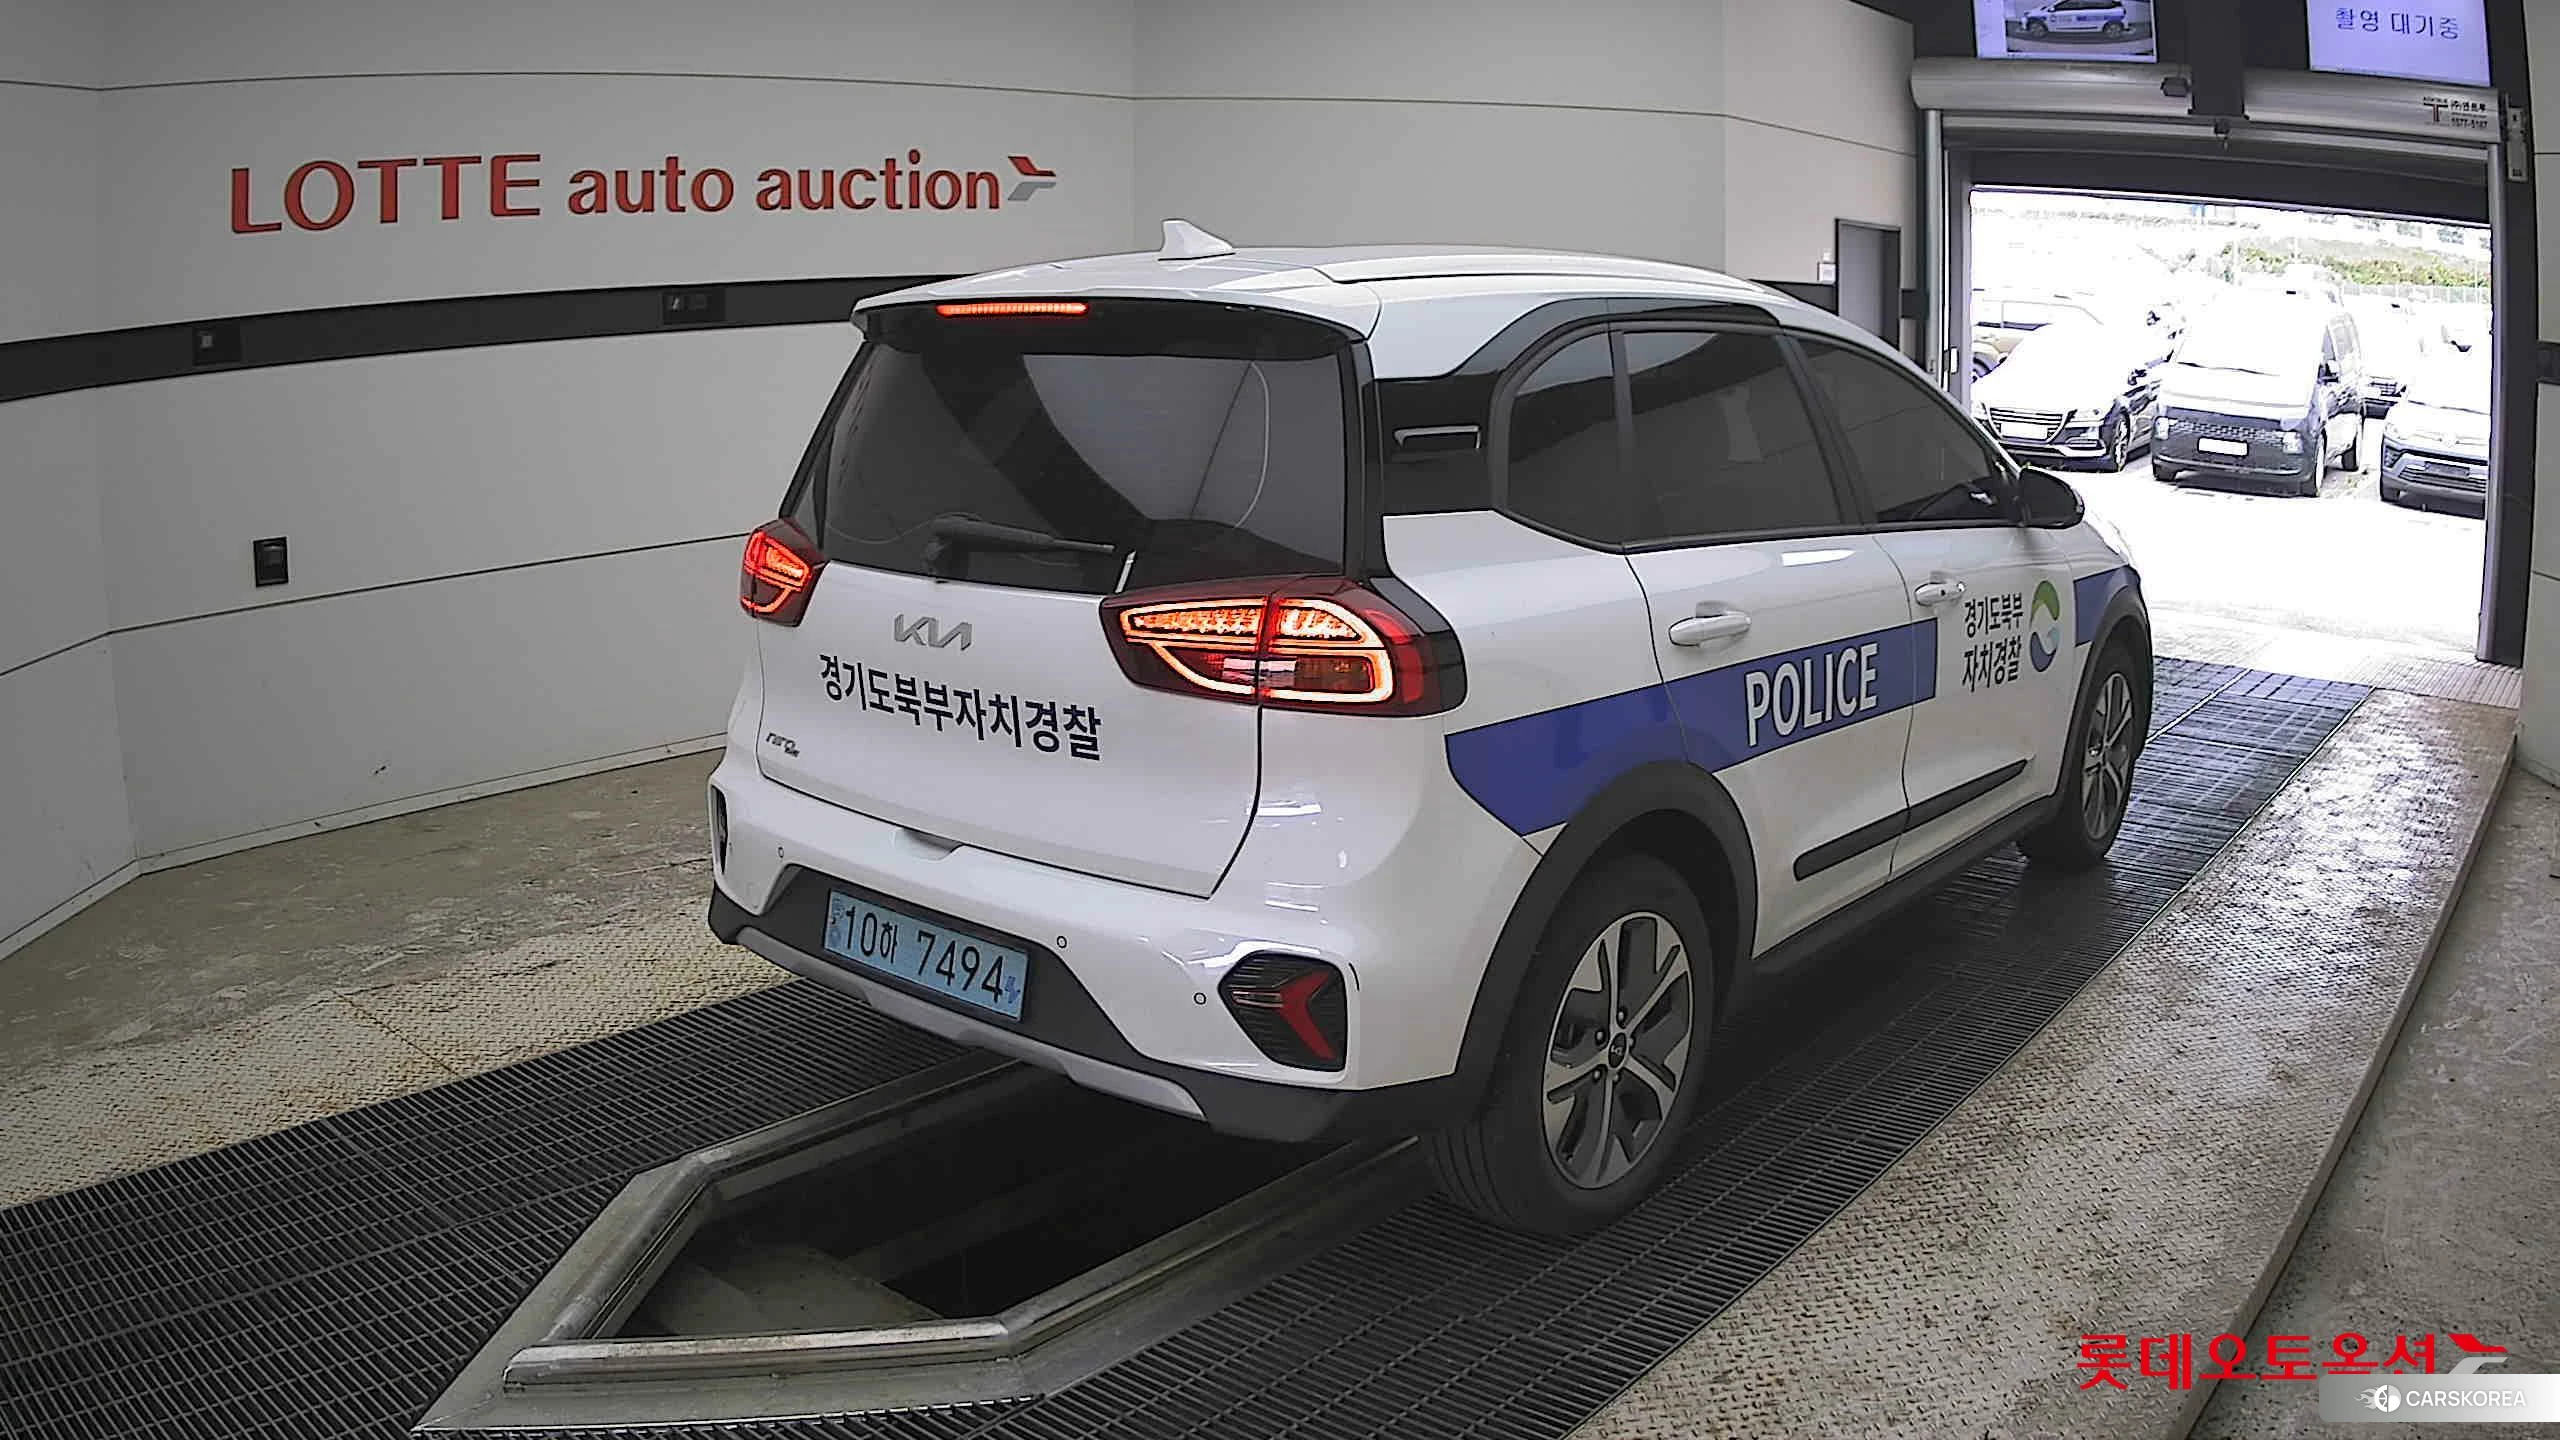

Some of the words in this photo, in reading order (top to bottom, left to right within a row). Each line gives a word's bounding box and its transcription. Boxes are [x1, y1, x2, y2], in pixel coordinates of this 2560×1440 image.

[2336, 7, 2379, 32] 촬영
[2391, 12, 2459, 40] 대기중
[231, 154, 541, 234] LOTTE
[568, 155, 734, 215] auto
[756, 149, 1001, 212] auction
[1964, 593, 2024, 639] 경기도북부
[1744, 642, 1880, 748] POLICE
[1962, 635, 2022, 693] 자치경찰
[820, 653, 1102, 761] 경기도북부자치경찰
[845, 905, 899, 965] 10하
[917, 929, 1005, 1004] 7494
